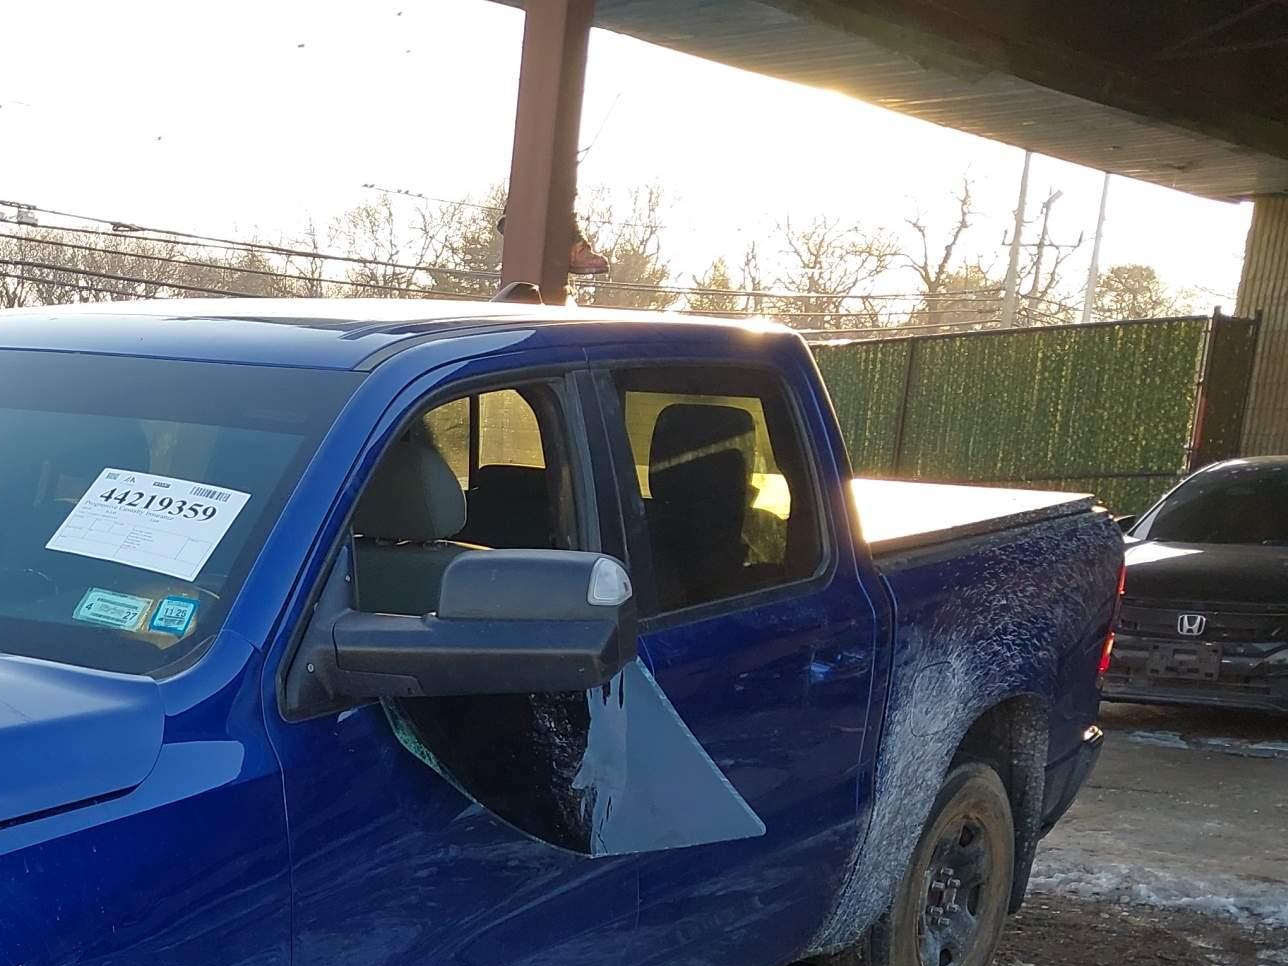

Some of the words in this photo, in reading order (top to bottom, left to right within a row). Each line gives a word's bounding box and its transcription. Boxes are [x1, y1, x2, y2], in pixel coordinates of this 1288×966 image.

[100, 488, 216, 521] 44219359
[85, 602, 94, 610] 4
[122, 611, 138, 621] 27
